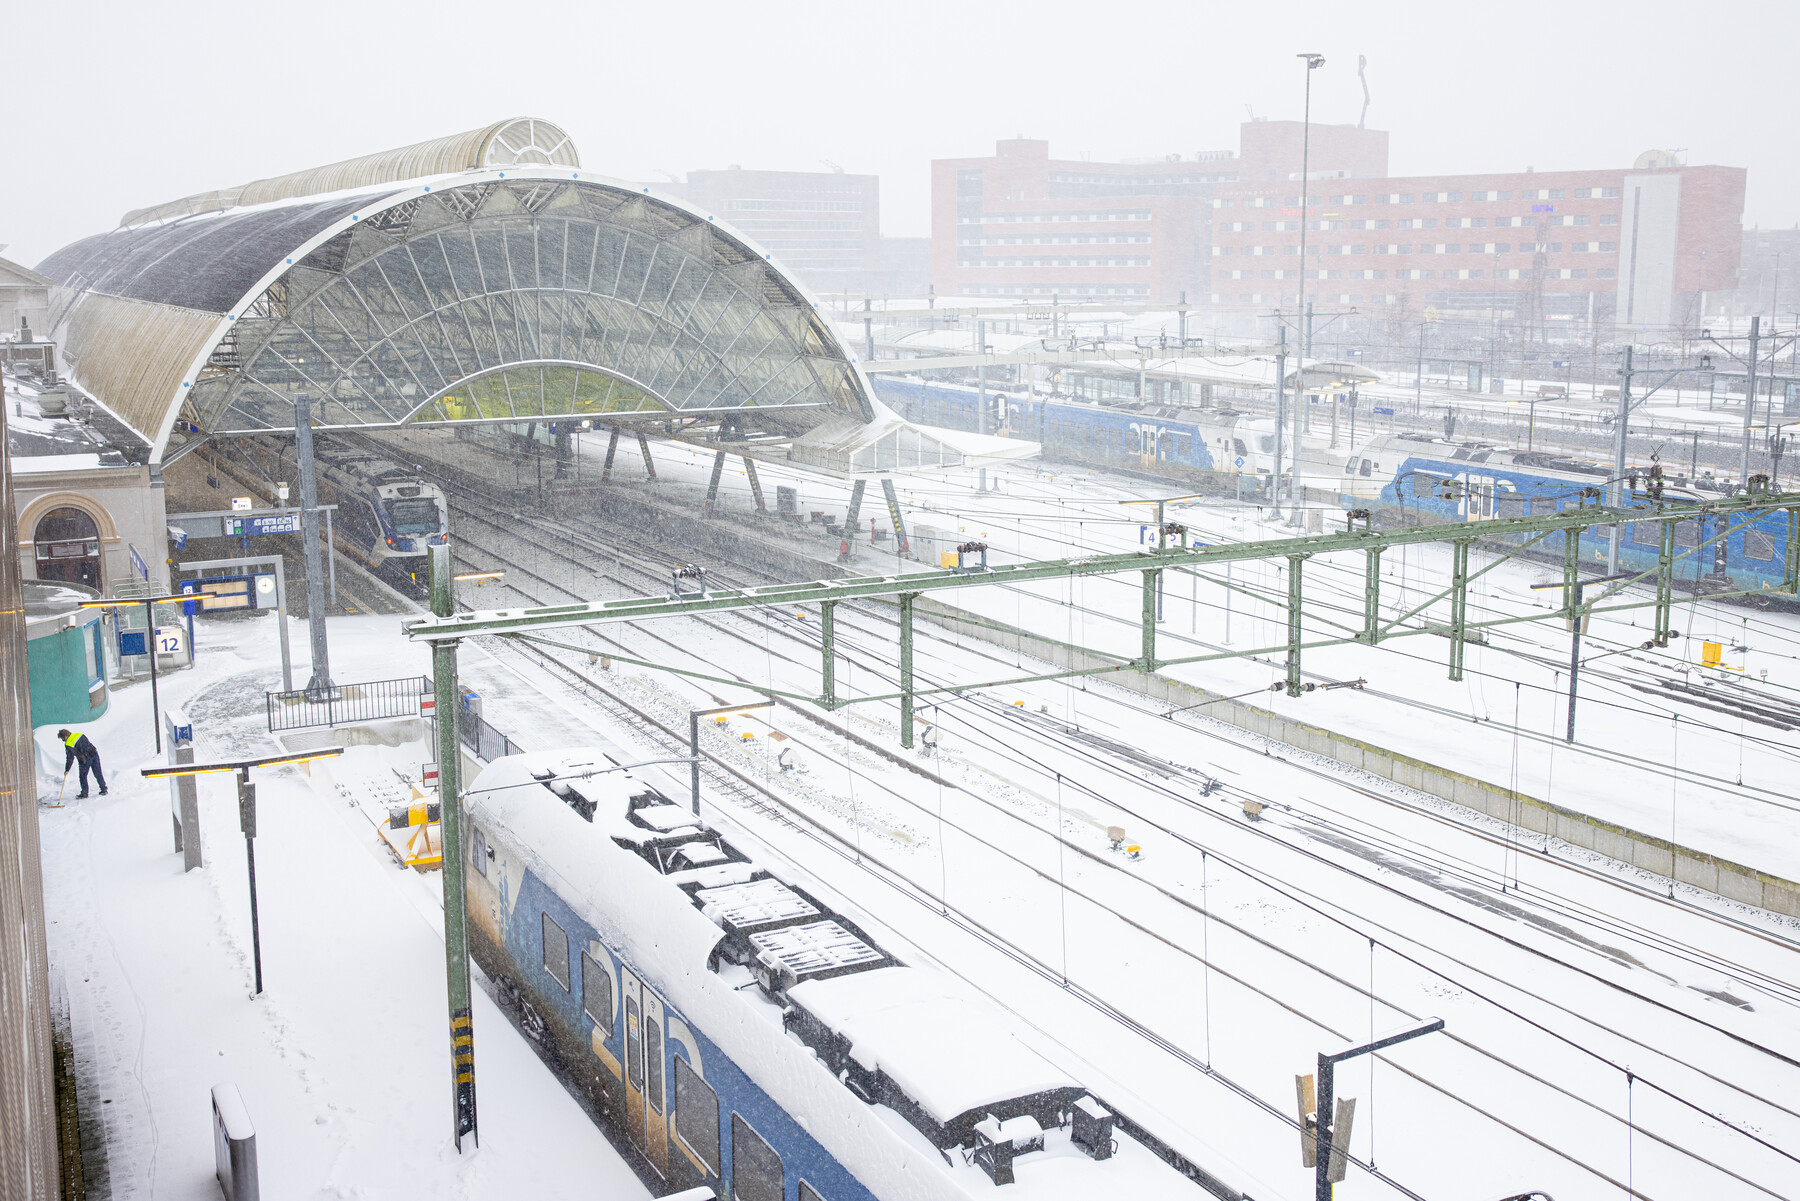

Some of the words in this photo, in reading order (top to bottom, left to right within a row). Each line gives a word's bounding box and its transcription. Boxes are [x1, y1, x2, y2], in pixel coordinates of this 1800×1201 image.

[1237, 458, 1242, 466] 3
[1148, 532, 1155, 542] 4
[1170, 532, 1177, 542] 5
[161, 638, 179, 652] 12
